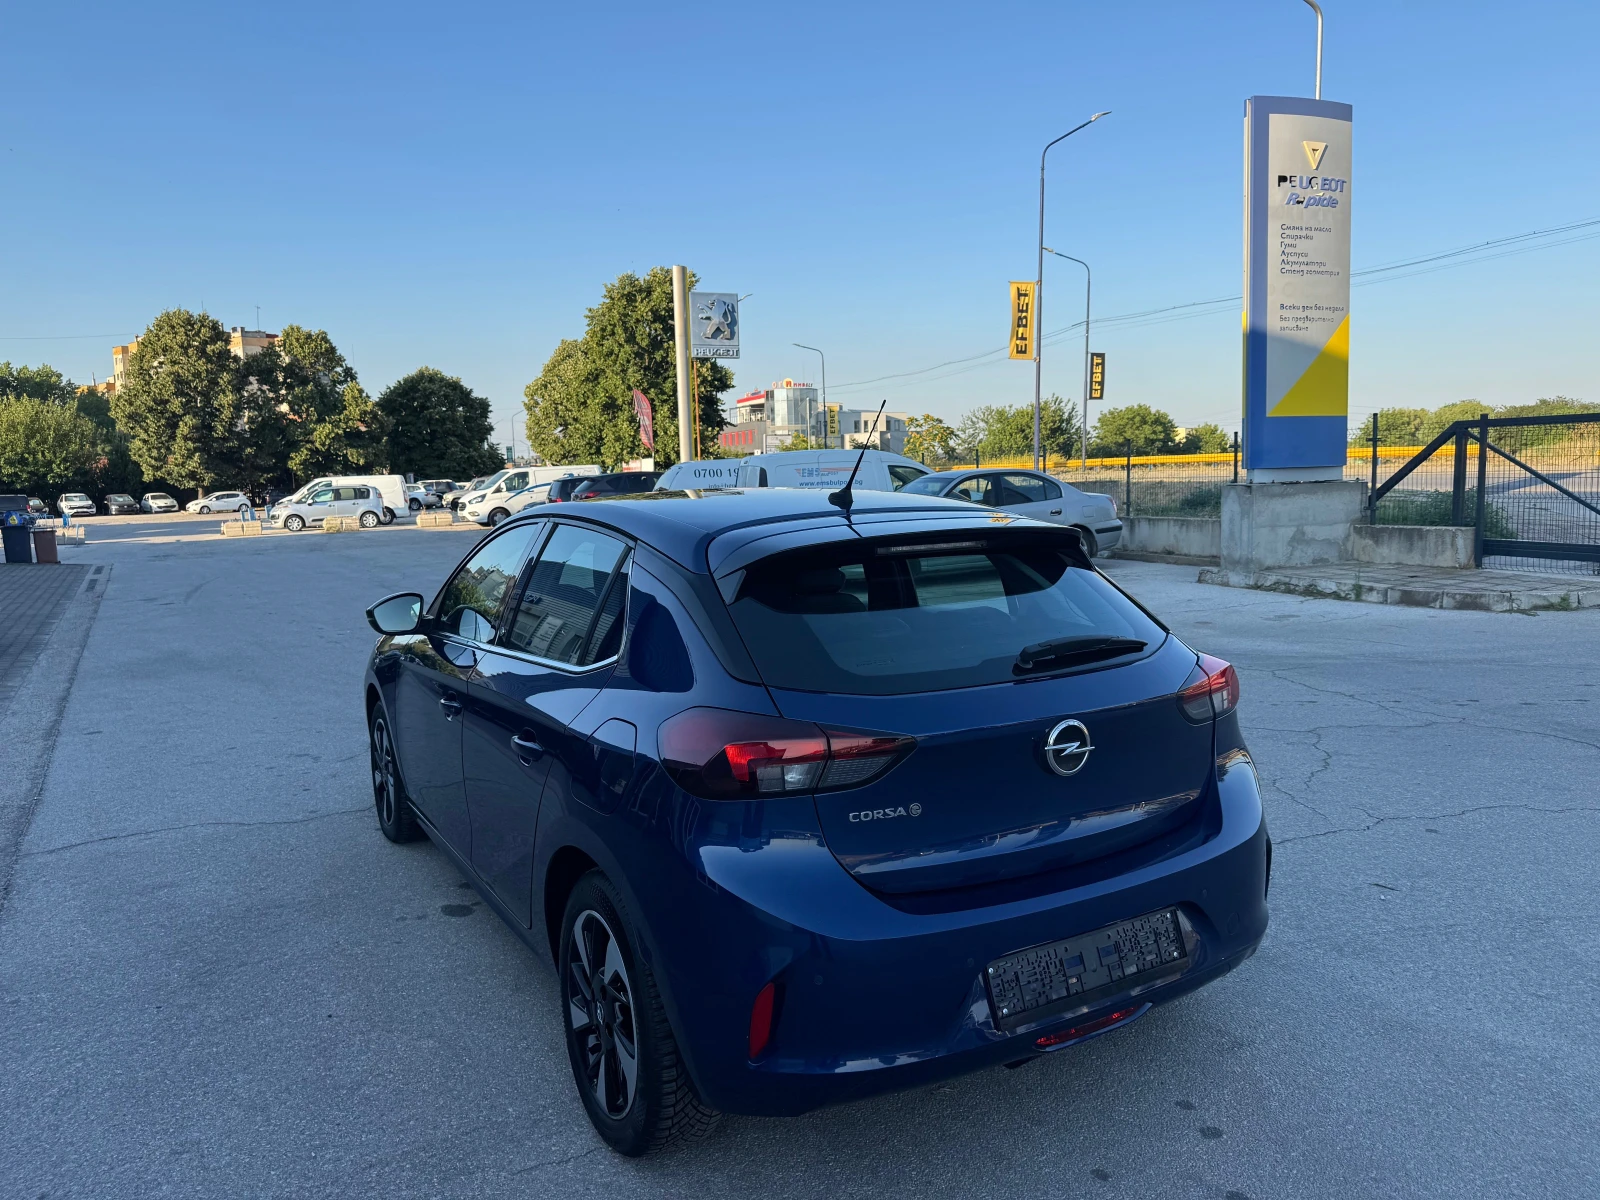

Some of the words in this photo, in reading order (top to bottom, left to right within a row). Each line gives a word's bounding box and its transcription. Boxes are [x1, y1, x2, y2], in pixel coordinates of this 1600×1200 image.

[1277, 175, 1347, 193] PEUGEOT
[1280, 223, 1303, 231] Смяна
[1280, 232, 1314, 241] Спирачки
[1280, 241, 1297, 249] Гуми
[1280, 250, 1308, 258] Ауспуси
[1280, 258, 1327, 268] Акумулатори
[1015, 286, 1029, 355] EFBET
[694, 347, 739, 357] PEUGEOT
[1091, 355, 1103, 398] EFBET
[693, 468, 723, 478] 0700
[801, 467, 820, 477] EMS
[848, 806, 907, 822] CORSA
